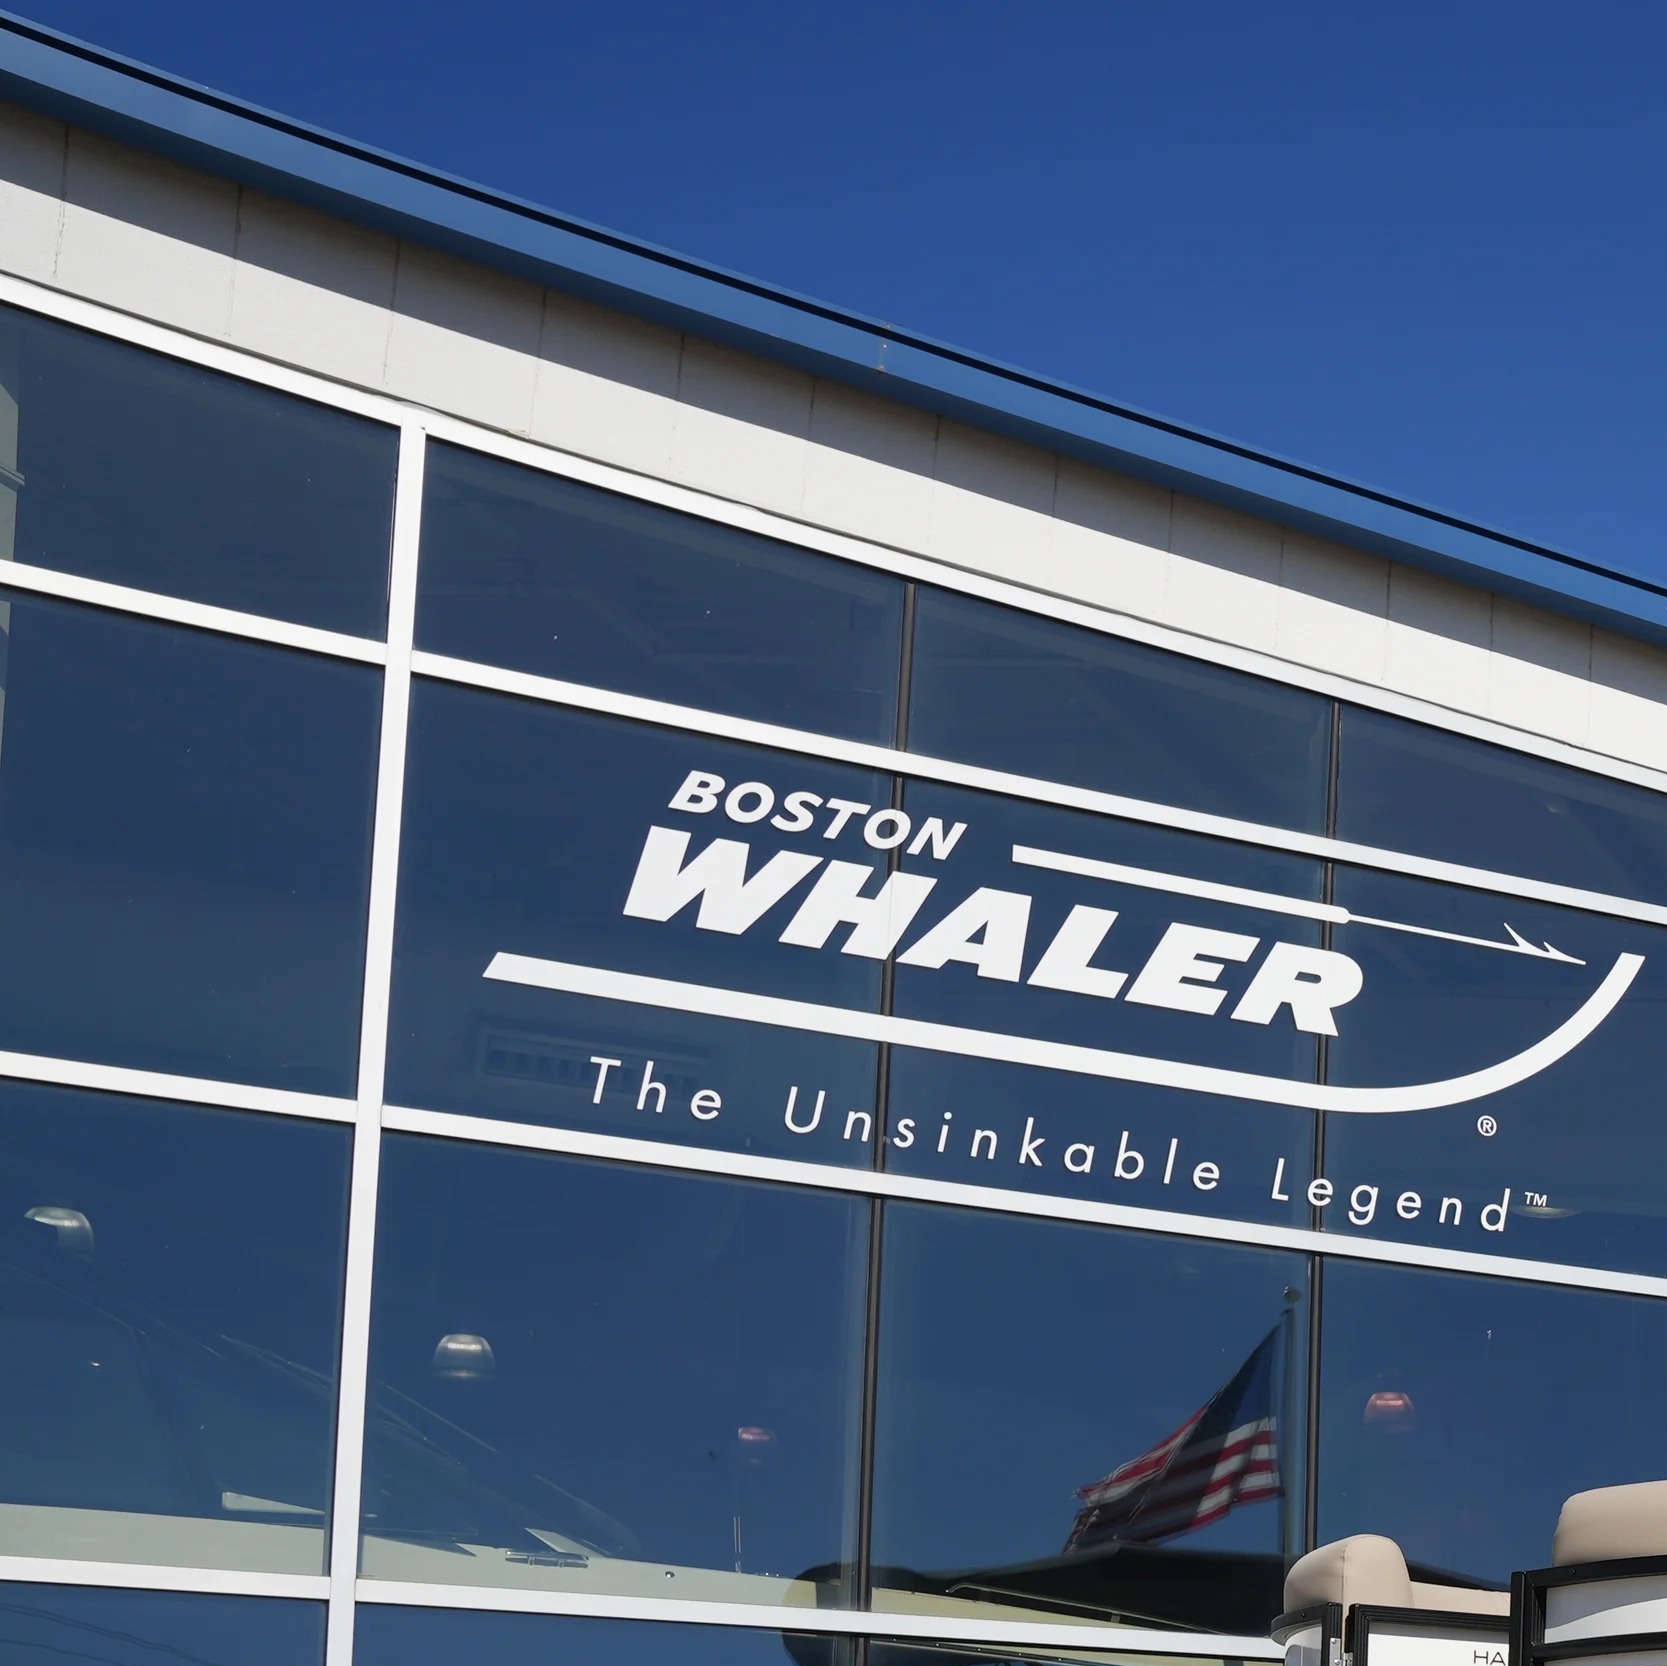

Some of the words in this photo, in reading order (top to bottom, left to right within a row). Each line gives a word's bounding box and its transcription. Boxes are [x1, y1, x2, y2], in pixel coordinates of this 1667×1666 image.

[668, 769, 967, 861] BOSTON
[623, 825, 1364, 1037] WHALER
[590, 1056, 722, 1123] The
[785, 1087, 1221, 1191] Unsinkable
